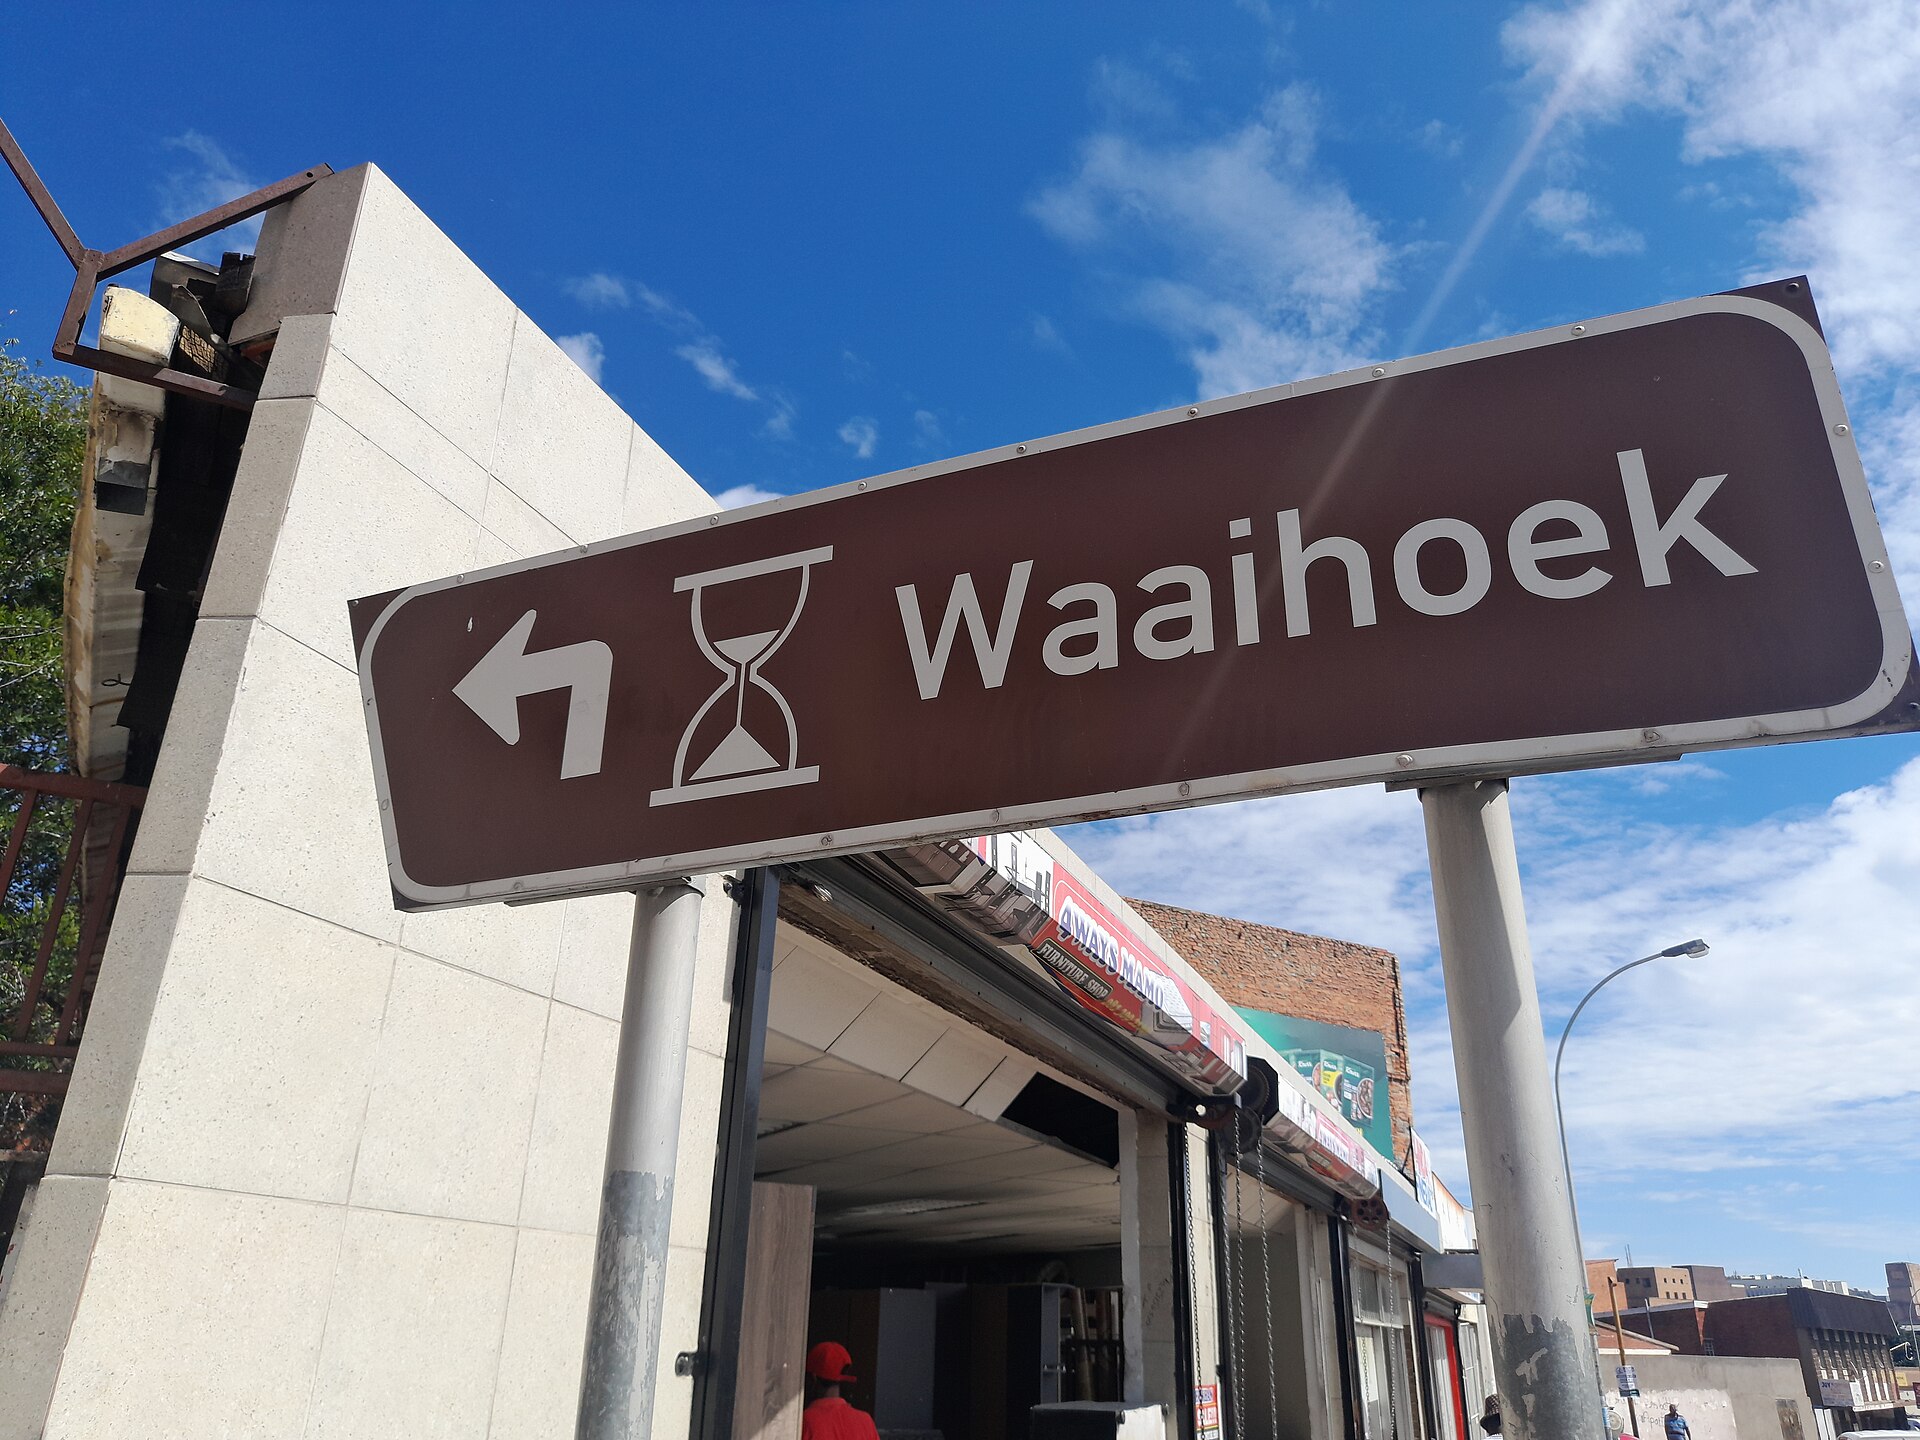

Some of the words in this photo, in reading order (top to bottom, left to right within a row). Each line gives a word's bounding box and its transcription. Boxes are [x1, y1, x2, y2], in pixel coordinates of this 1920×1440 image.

[895, 449, 1759, 700] Waaihoek
[1038, 943, 1088, 985] FURNITURE
[1086, 980, 1109, 999] SHOP
[1057, 896, 1119, 975] 4WAYS
